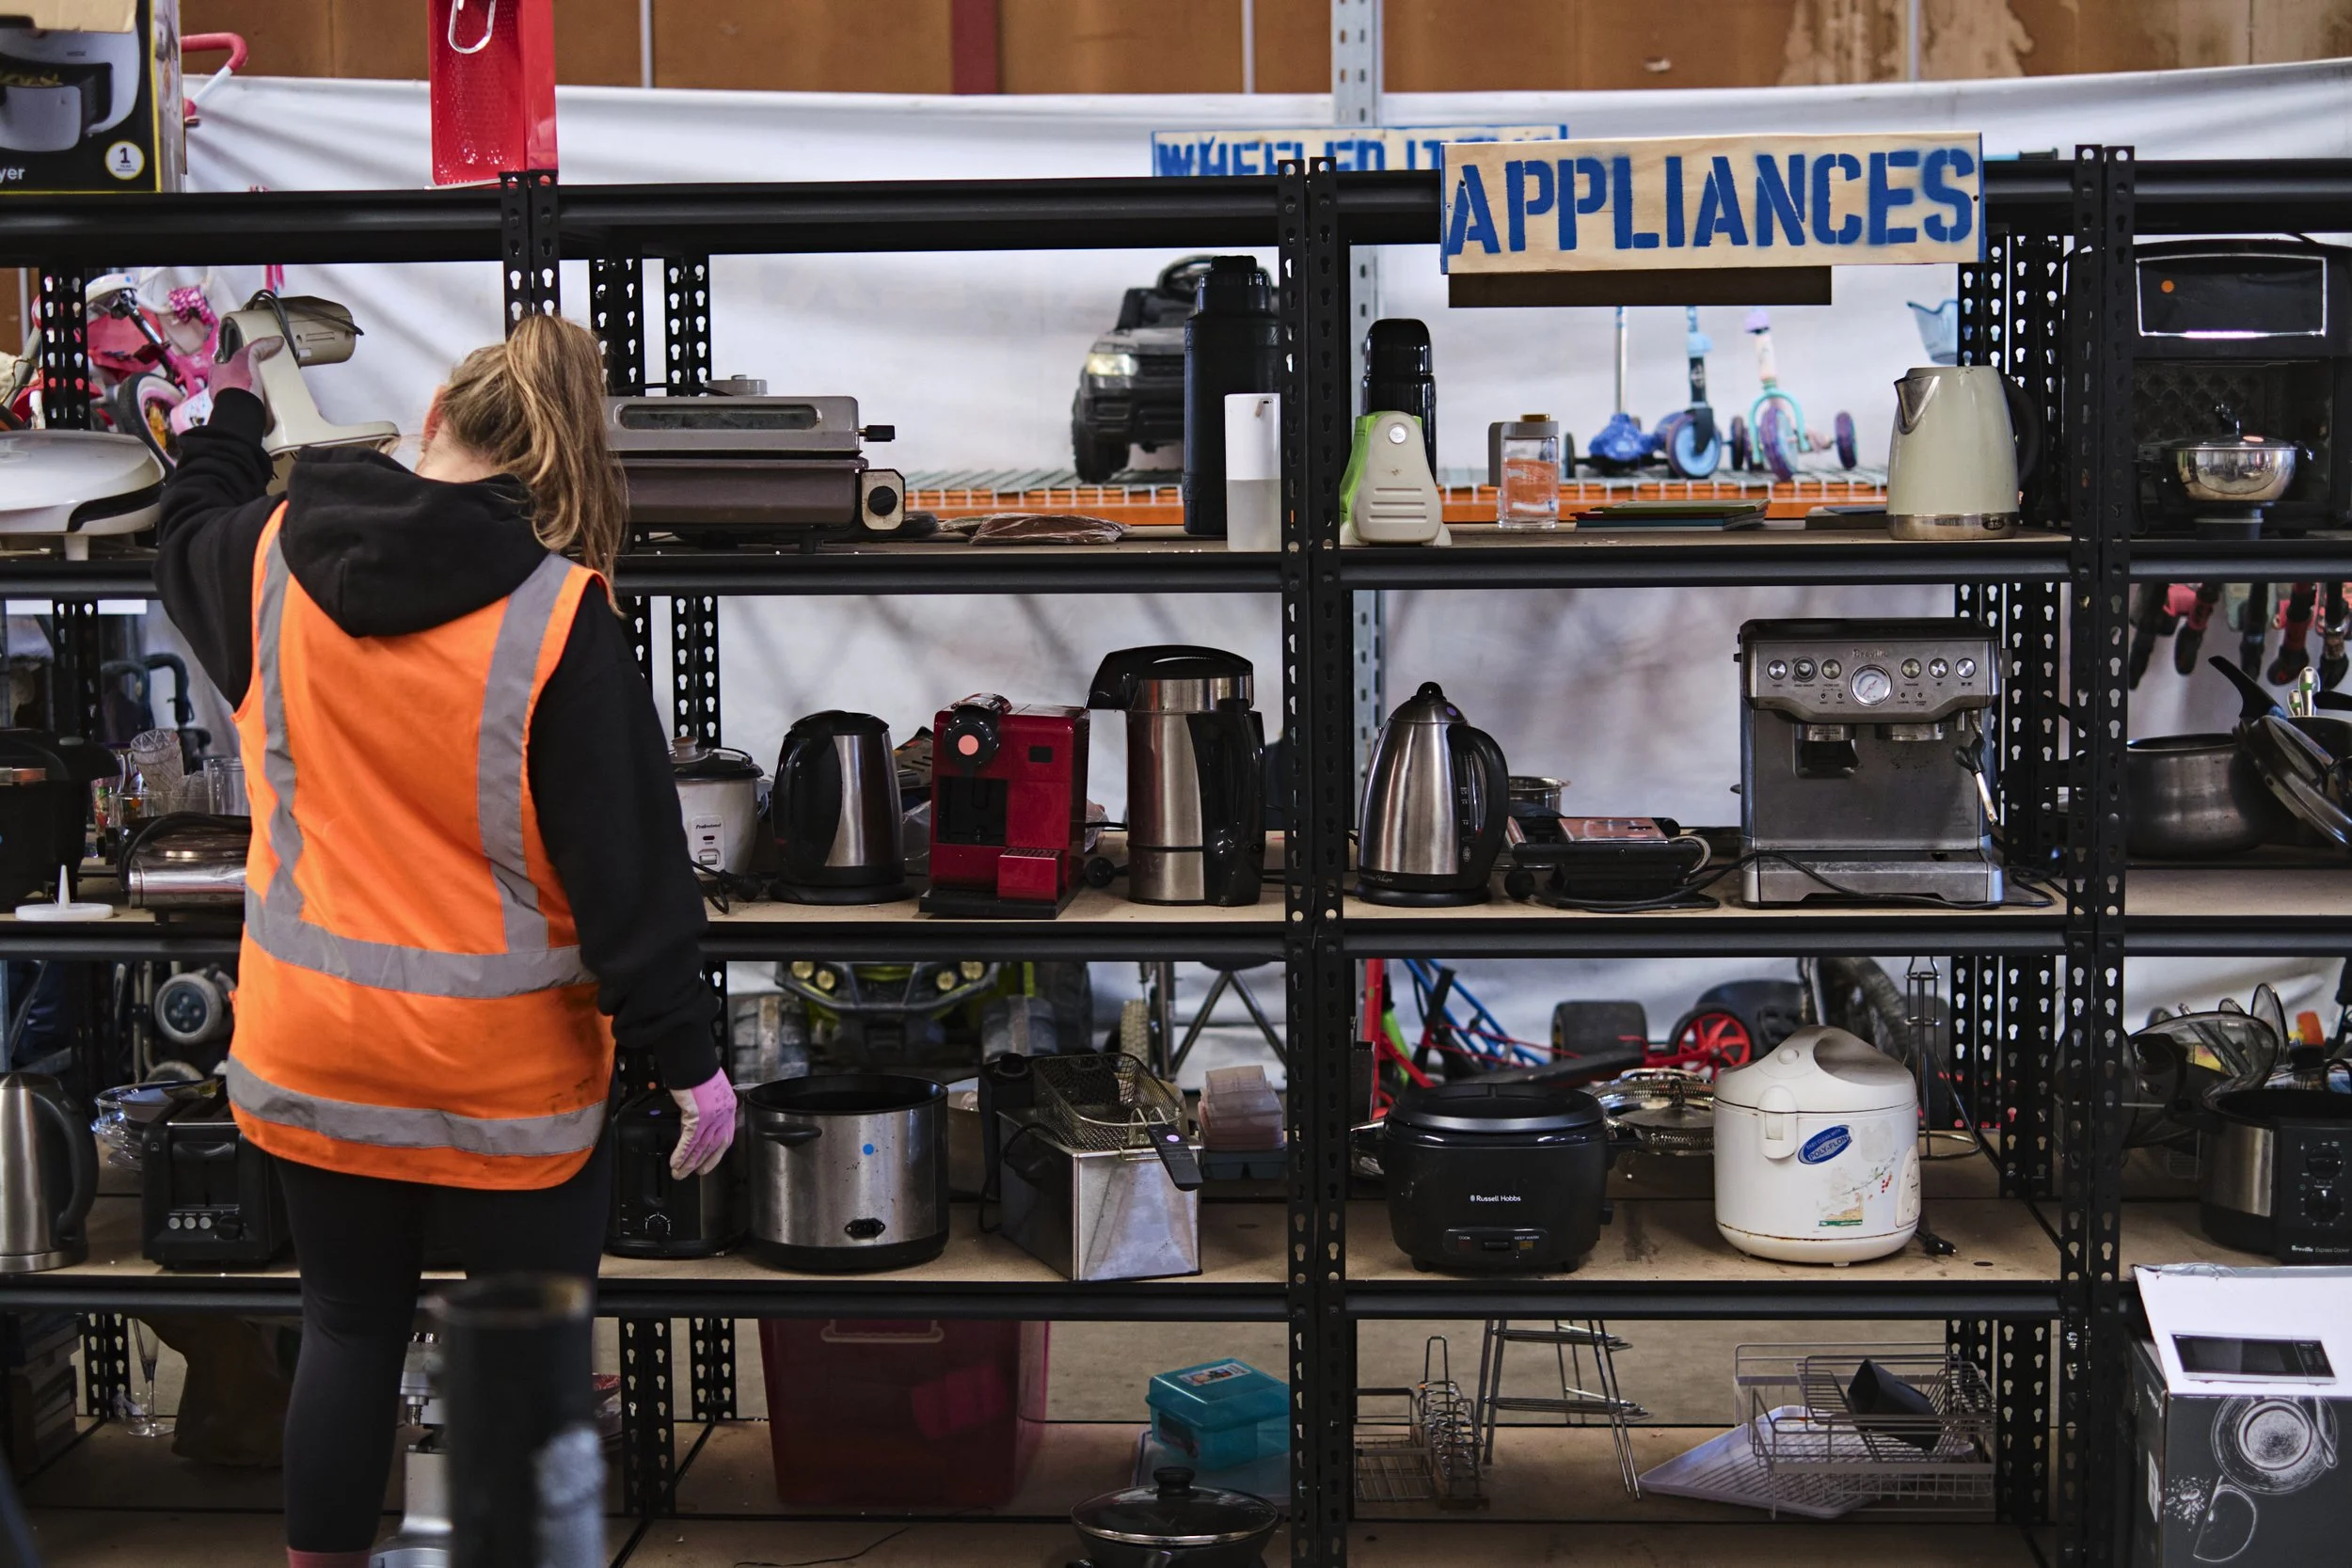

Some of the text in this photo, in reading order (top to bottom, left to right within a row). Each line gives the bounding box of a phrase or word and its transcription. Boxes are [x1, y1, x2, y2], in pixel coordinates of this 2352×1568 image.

[119, 147, 131, 164] 1
[1447, 149, 1975, 255] APPLIANCES
[1808, 1134, 1848, 1160] POLY-FLON
